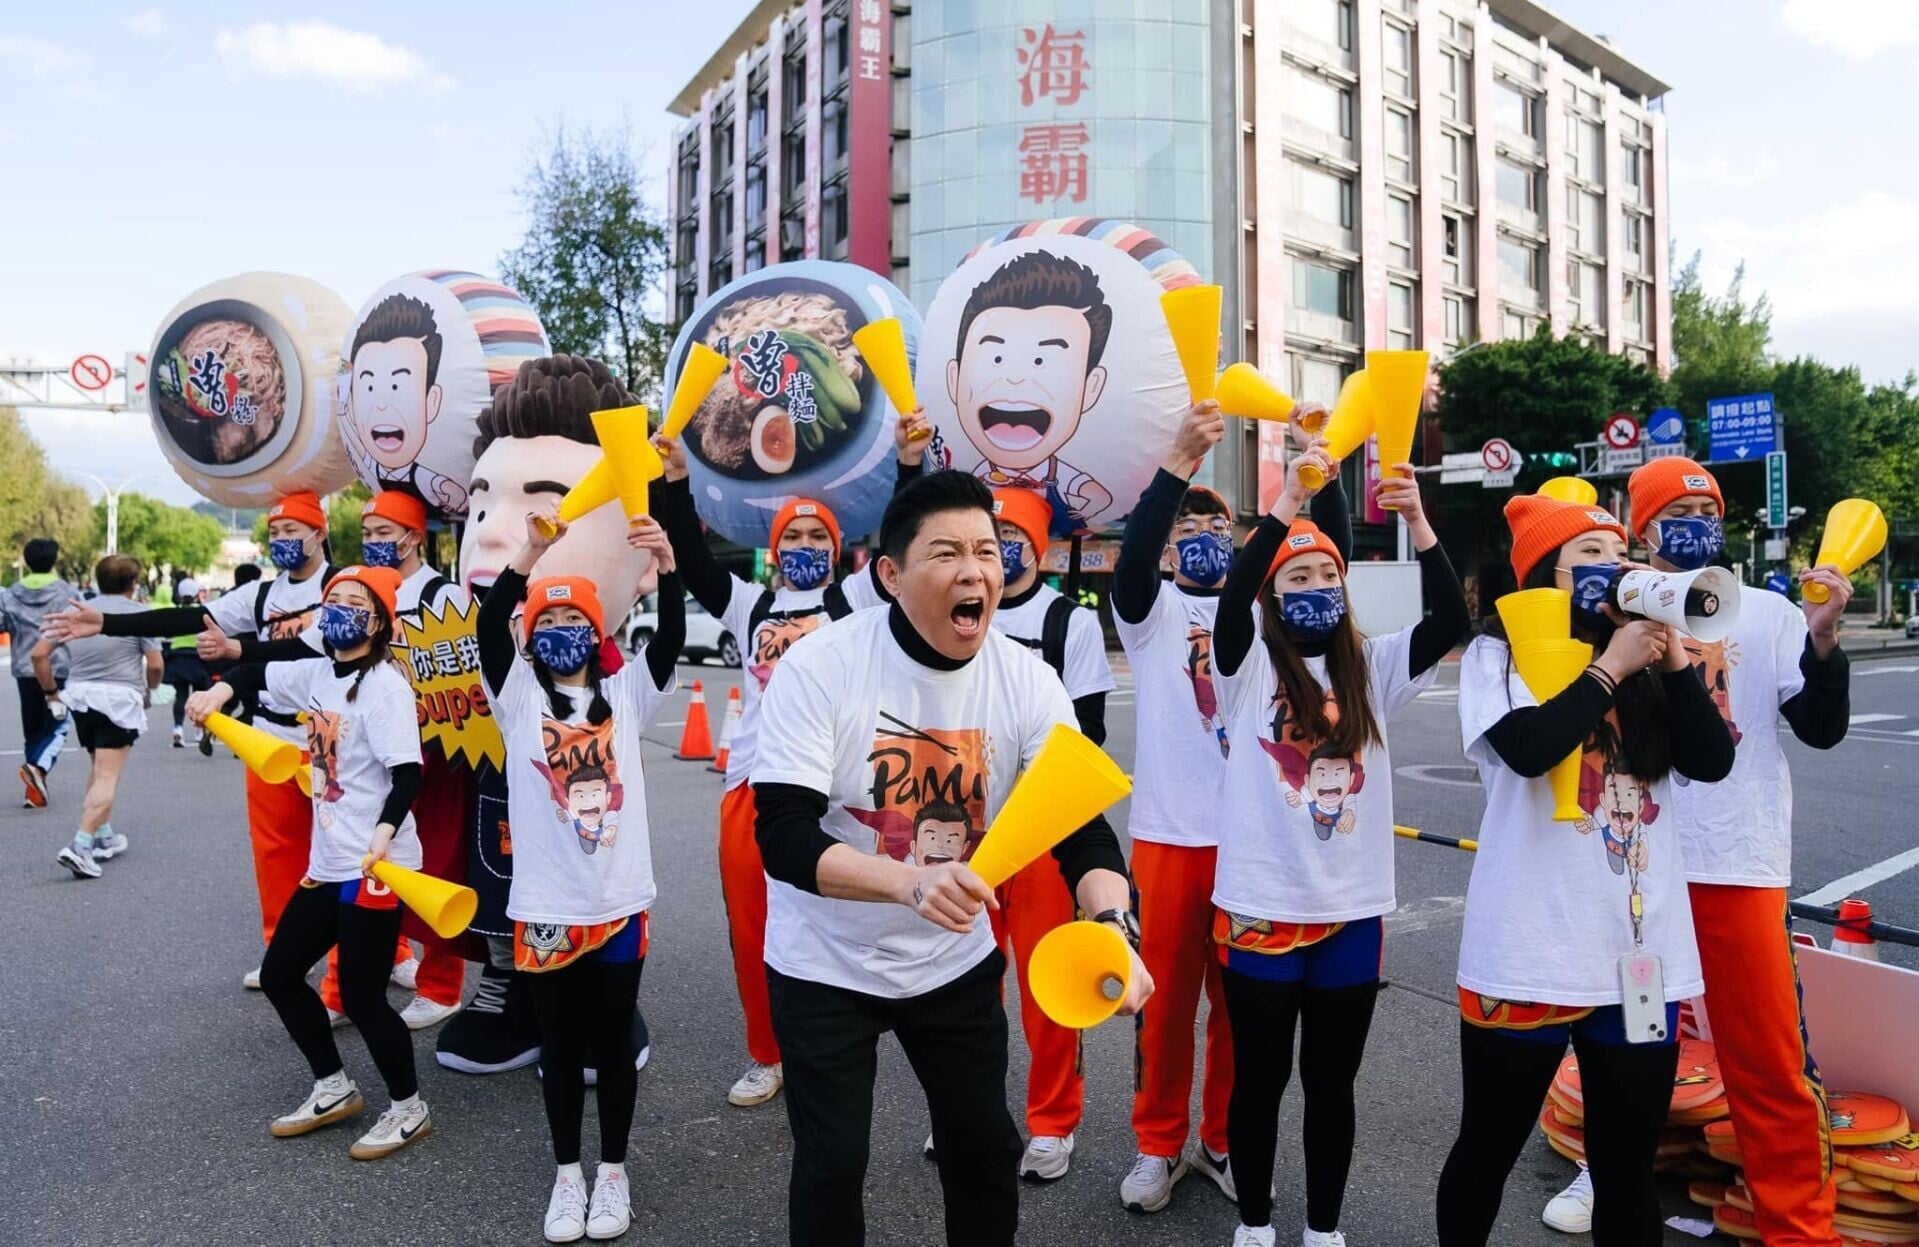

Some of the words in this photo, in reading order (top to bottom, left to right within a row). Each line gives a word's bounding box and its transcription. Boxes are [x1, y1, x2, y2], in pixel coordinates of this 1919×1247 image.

[859, 0, 881, 80] 海霸王
[1015, 22, 1092, 204] 海霸
